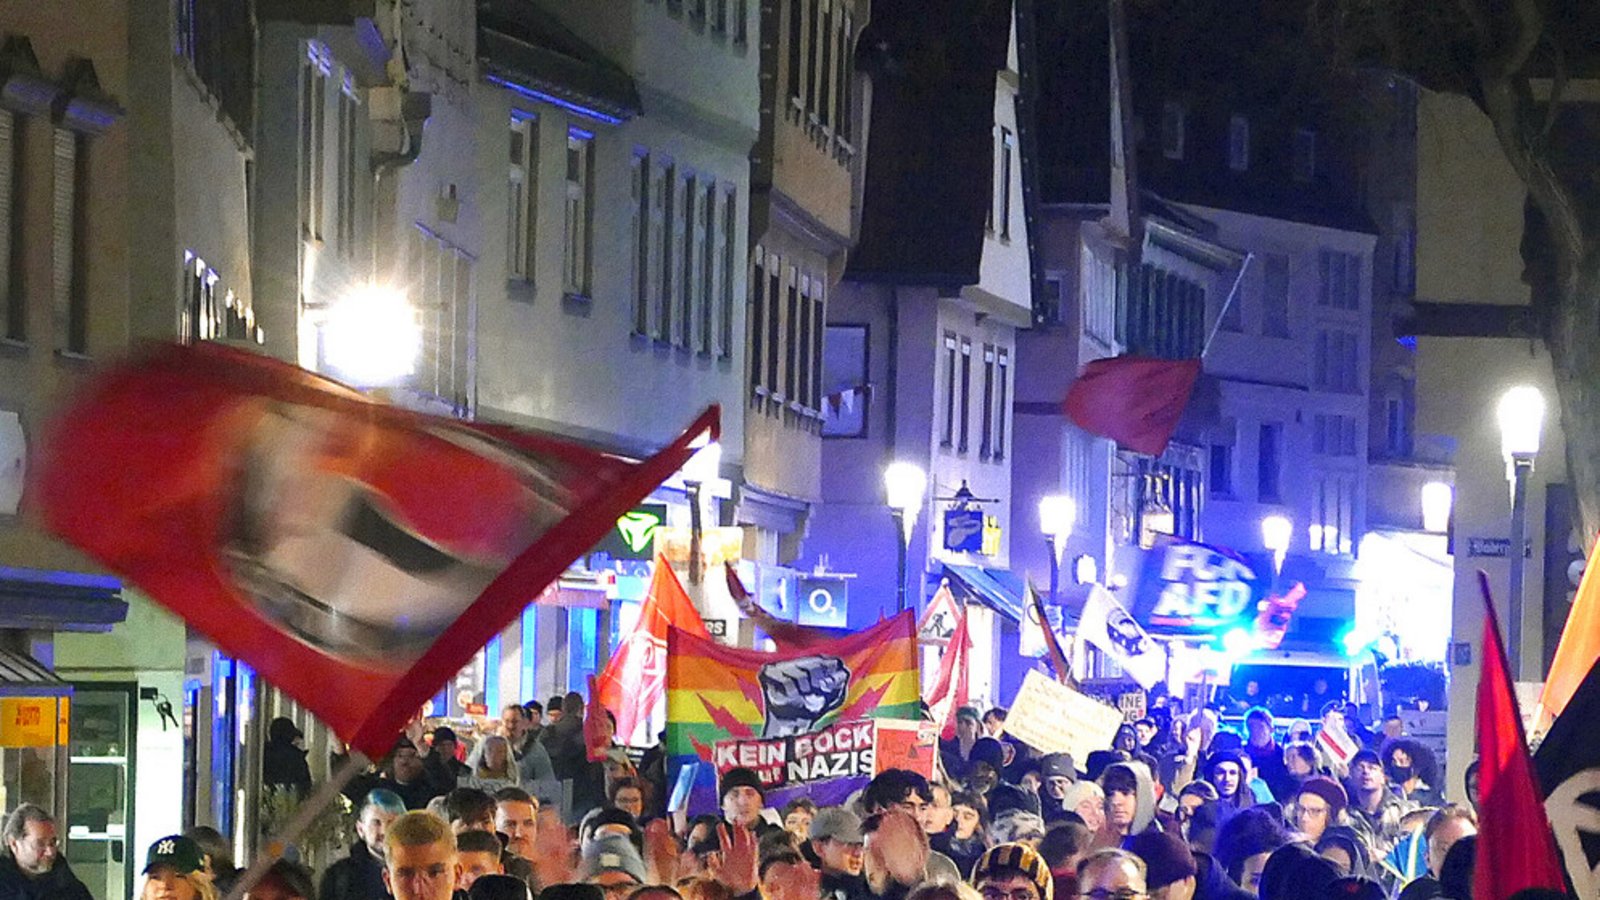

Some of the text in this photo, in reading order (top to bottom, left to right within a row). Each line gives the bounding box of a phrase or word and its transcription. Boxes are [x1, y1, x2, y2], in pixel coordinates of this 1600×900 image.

[717, 742, 786, 767] KEIN
[795, 725, 872, 759] BOCK
[787, 750, 873, 780] NAZIS
